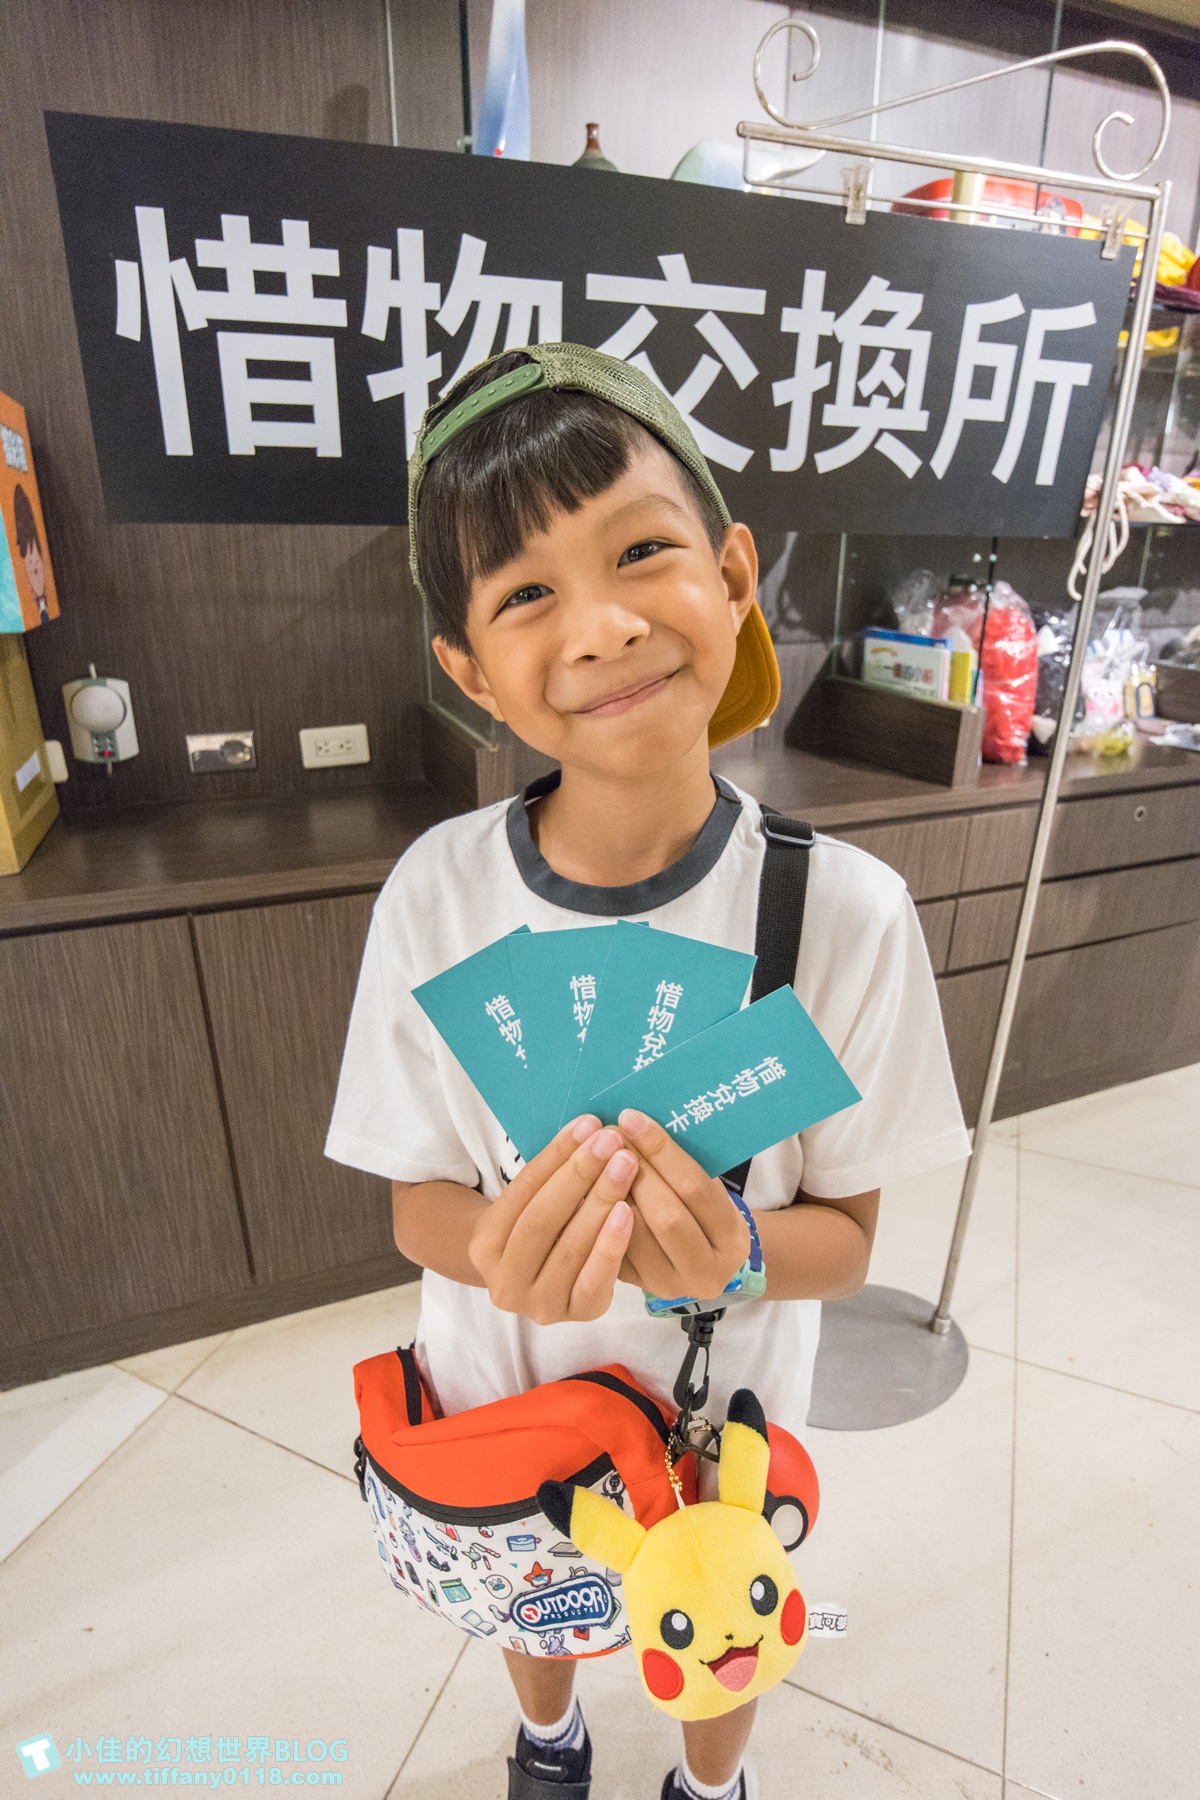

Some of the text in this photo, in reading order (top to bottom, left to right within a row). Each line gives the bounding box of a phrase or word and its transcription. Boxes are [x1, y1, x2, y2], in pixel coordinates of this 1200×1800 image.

[115, 205, 1097, 486] 惜物交換所
[570, 974, 597, 1051] 惜物
[520, 1586, 606, 1623] OUTDOOR
[543, 1606, 594, 1620] PRODUCTS
